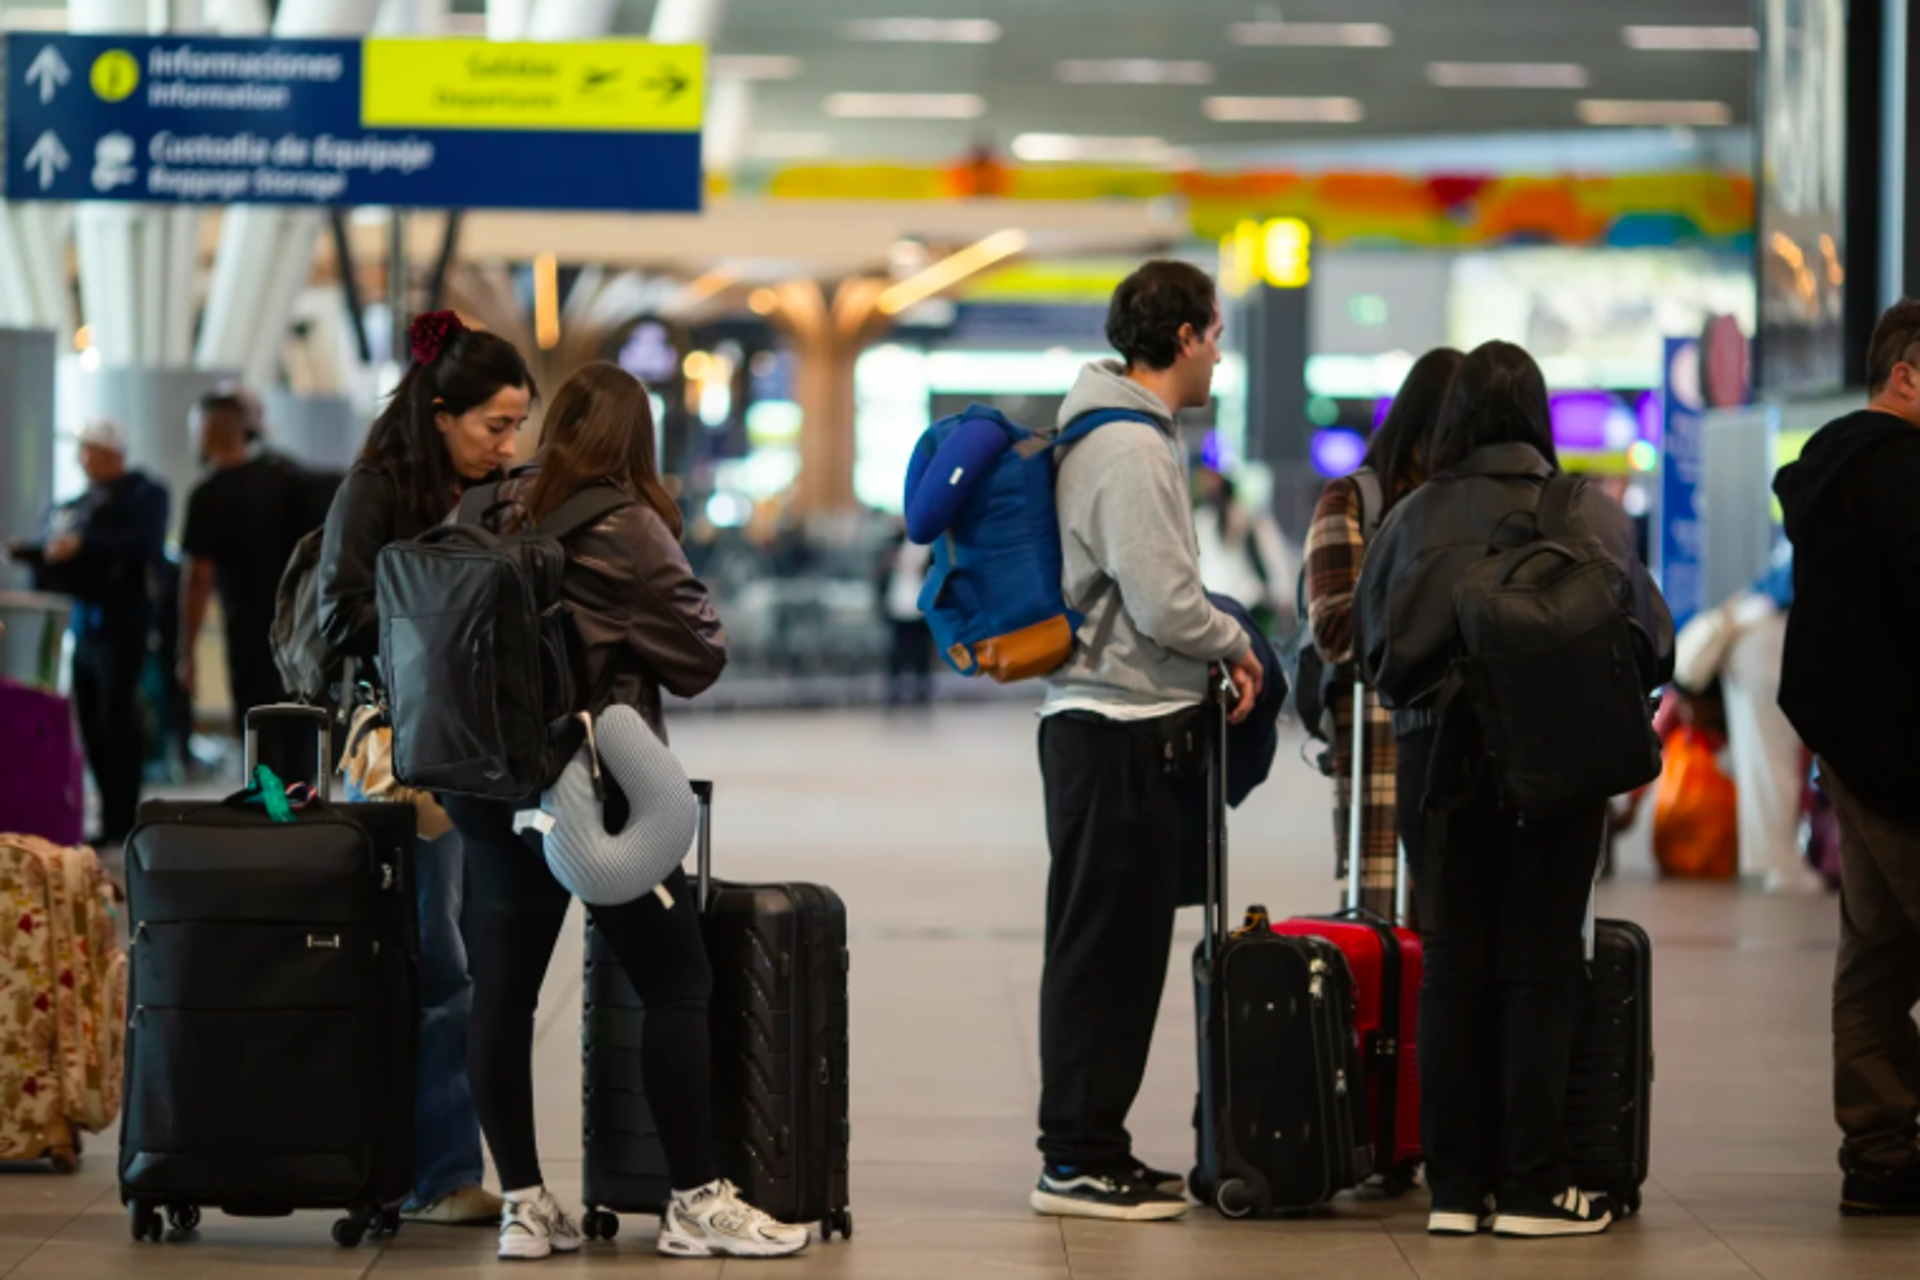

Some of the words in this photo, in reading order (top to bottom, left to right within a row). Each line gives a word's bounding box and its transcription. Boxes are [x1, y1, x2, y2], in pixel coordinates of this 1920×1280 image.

[149, 46, 344, 81] Informaciones
[149, 131, 270, 166] Custodia
[272, 135, 311, 166] de
[313, 134, 434, 174] Equipaje
